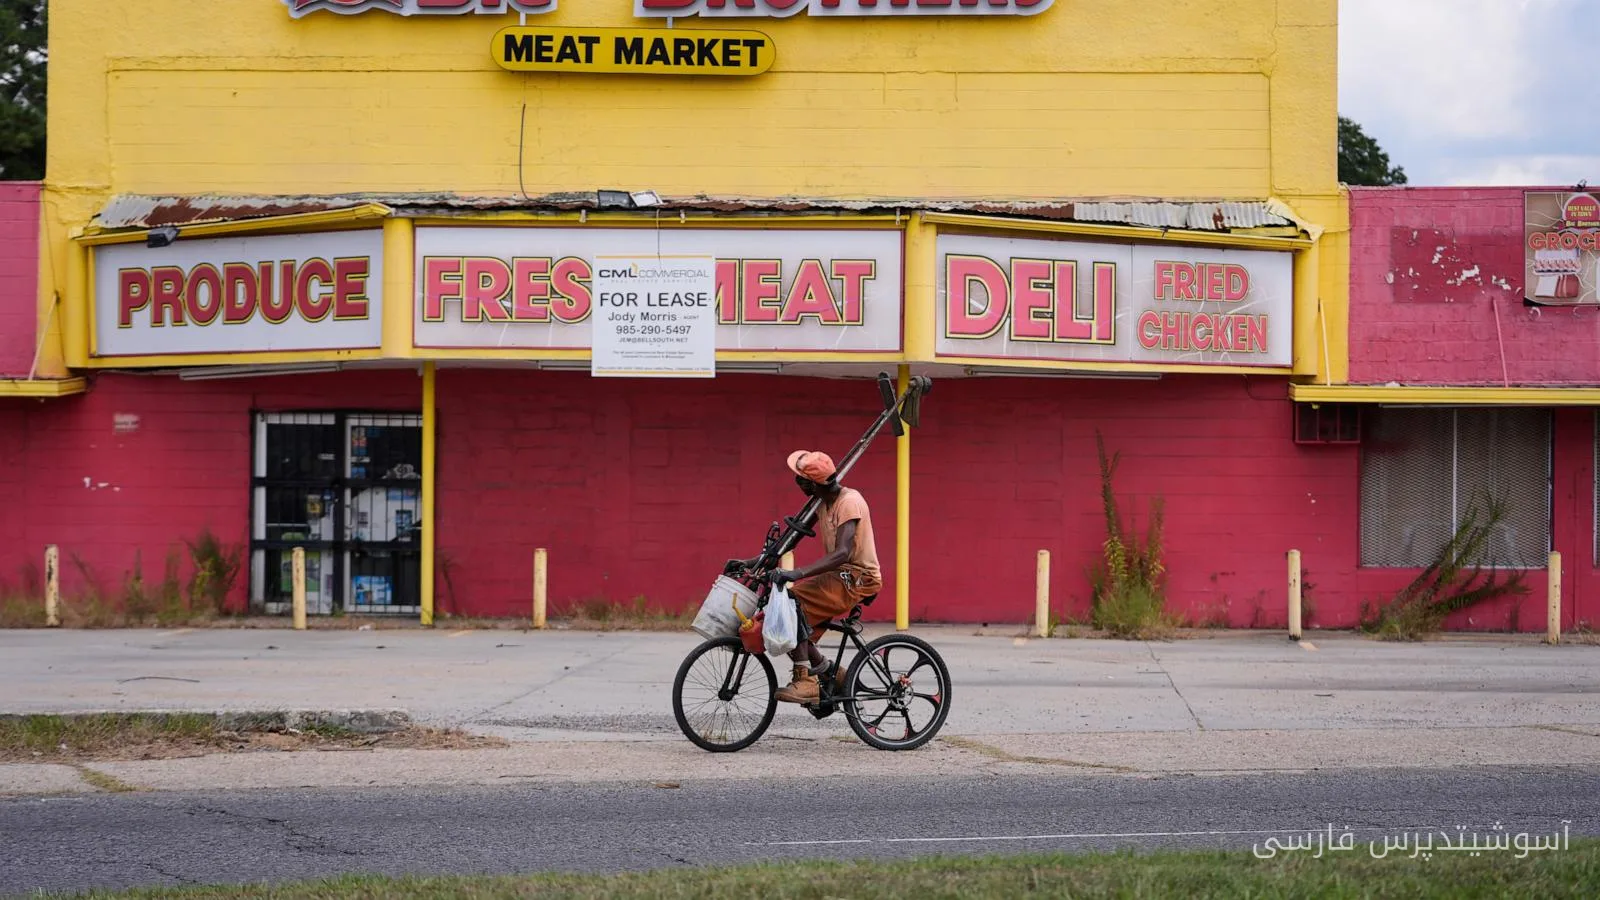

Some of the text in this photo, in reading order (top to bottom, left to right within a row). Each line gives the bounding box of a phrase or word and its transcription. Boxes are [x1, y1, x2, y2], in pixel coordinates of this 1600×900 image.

[504, 35, 765, 67] MEAT MARKET
[118, 256, 370, 328] PRODUCE
[423, 255, 592, 324] FRES
[600, 292, 708, 307] FOR LEASE
[945, 253, 1116, 345] DELI
[1154, 260, 1250, 303] FRIED
[608, 312, 635, 323] Jody
[640, 312, 677, 321] Morris
[616, 325, 691, 335] 985-290-5497
[1137, 310, 1268, 353] CHICKEN
